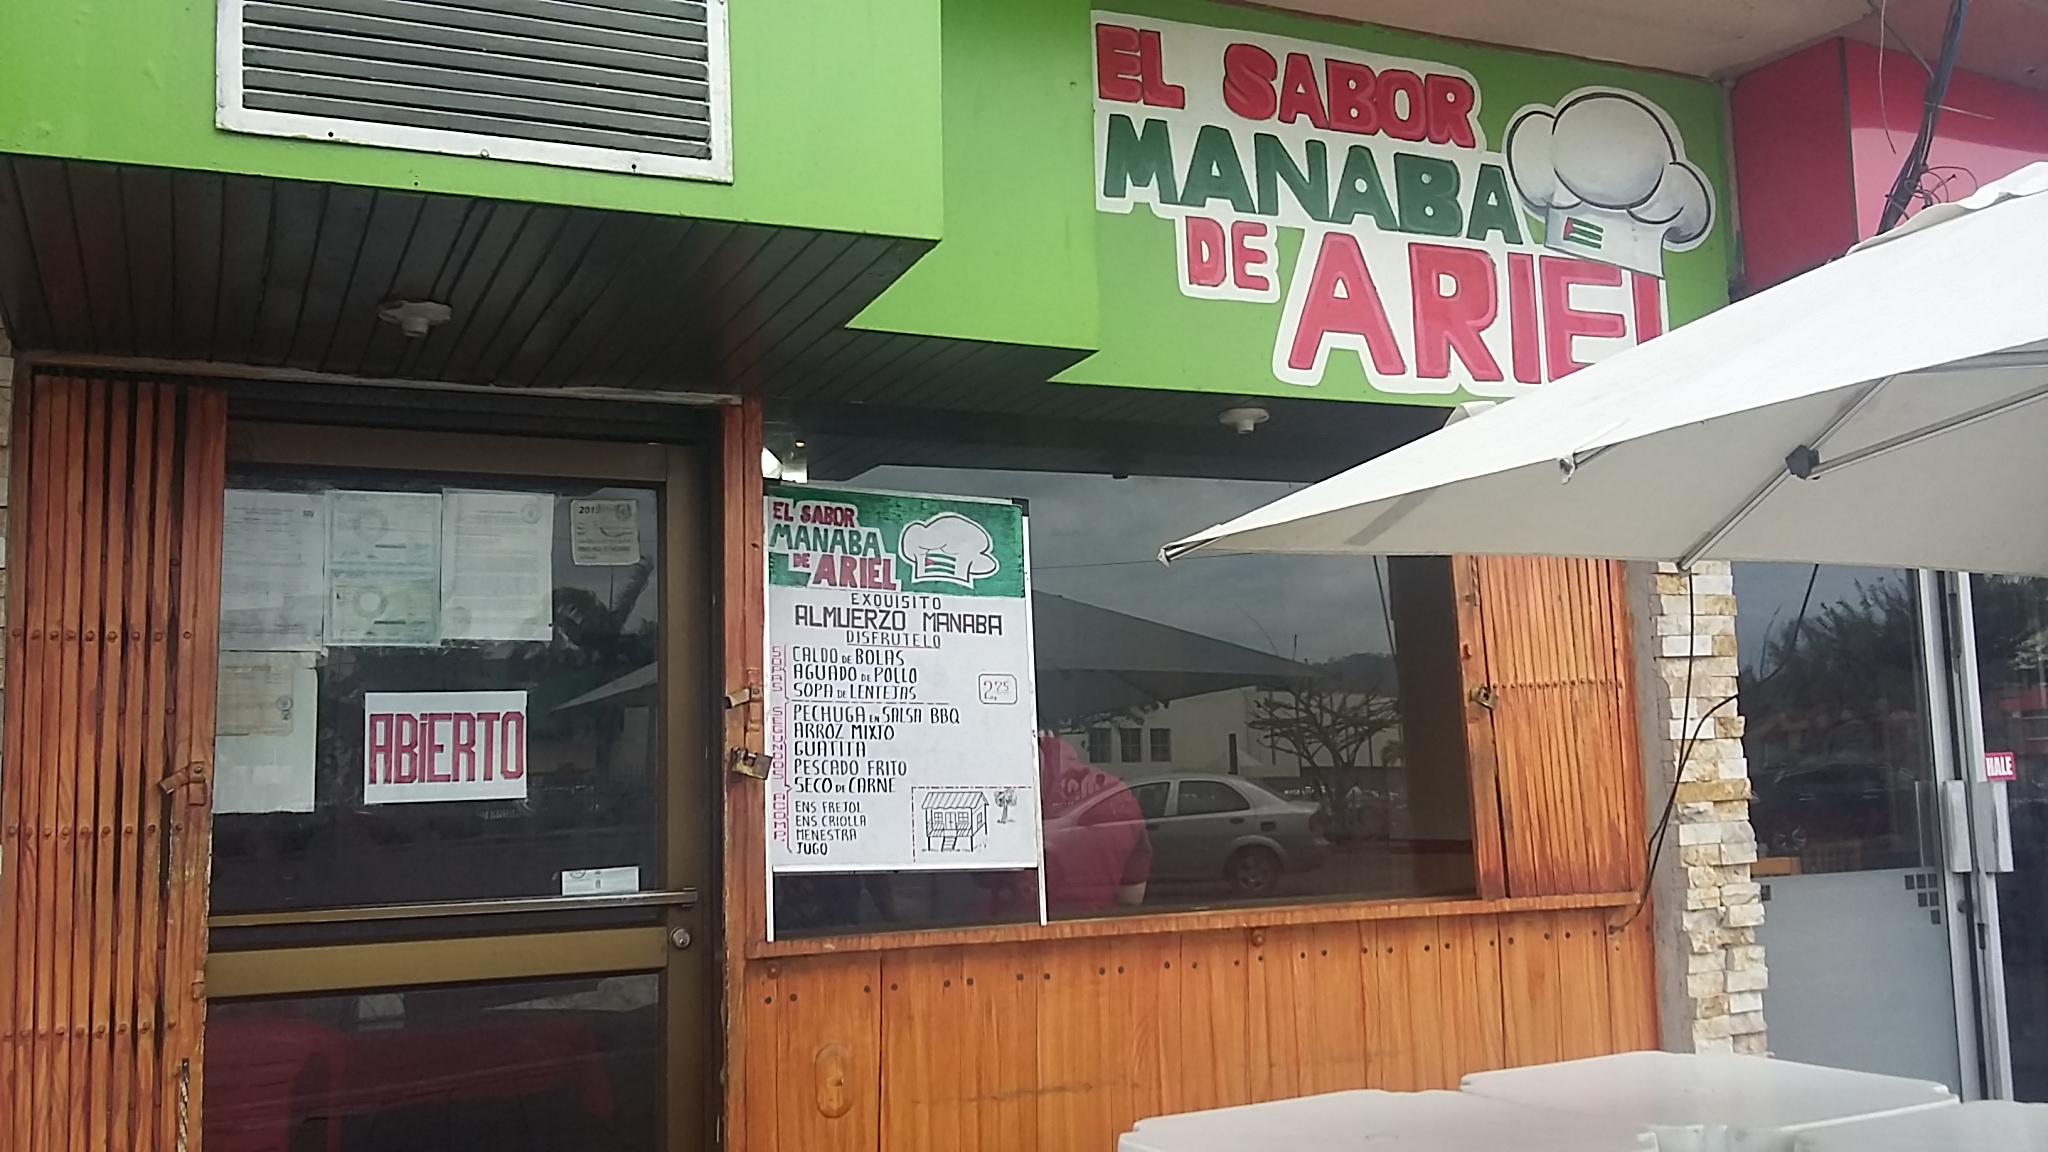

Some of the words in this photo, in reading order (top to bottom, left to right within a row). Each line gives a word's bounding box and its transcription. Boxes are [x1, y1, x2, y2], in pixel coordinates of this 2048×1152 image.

[1096, 23, 1185, 110] EL
[1223, 43, 1475, 148] SABOR
[1103, 113, 1523, 245] MANABA
[1185, 216, 1270, 291] DE
[773, 501, 794, 522] EL
[800, 505, 855, 528] SABOR
[769, 523, 881, 558] MANABA
[793, 552, 810, 568] DE
[812, 554, 897, 590] ARIEL
[795, 605, 906, 631] ALMUERZO
[923, 612, 1003, 636] MANABA
[846, 630, 941, 647] DISFRUTELO
[793, 646, 838, 664] CALDO
[842, 655, 852, 664] DE
[856, 648, 905, 666] BOLAS
[771, 645, 783, 692] SOPAS
[794, 663, 857, 682] AGUADO
[861, 673, 871, 682] DE
[874, 667, 917, 684] POLLO
[793, 682, 833, 698] SOPA
[837, 689, 846, 698] DE
[850, 684, 916, 700] LENTEJAS
[794, 704, 866, 723] PECHUGA
[869, 714, 880, 723] EN
[882, 706, 922, 724] SALSA
[930, 708, 960, 724] BBQ
[794, 722, 844, 739] ARROZ
[851, 725, 895, 740] MIXTO
[794, 740, 866, 757] GUATITA
[794, 758, 859, 775] PESCADO
[867, 760, 907, 776] FRITO
[1986, 756, 2013, 777] HALE
[794, 777, 832, 793] SECO
[835, 784, 845, 793] DE
[849, 777, 896, 793] CARNE
[795, 801, 816, 813] ENS
[822, 801, 862, 813] FREJOL
[795, 815, 817, 827] ENS
[821, 815, 866, 827] CRIOLLA
[796, 828, 857, 841] MENESTRA
[796, 842, 828, 855] JUGO
